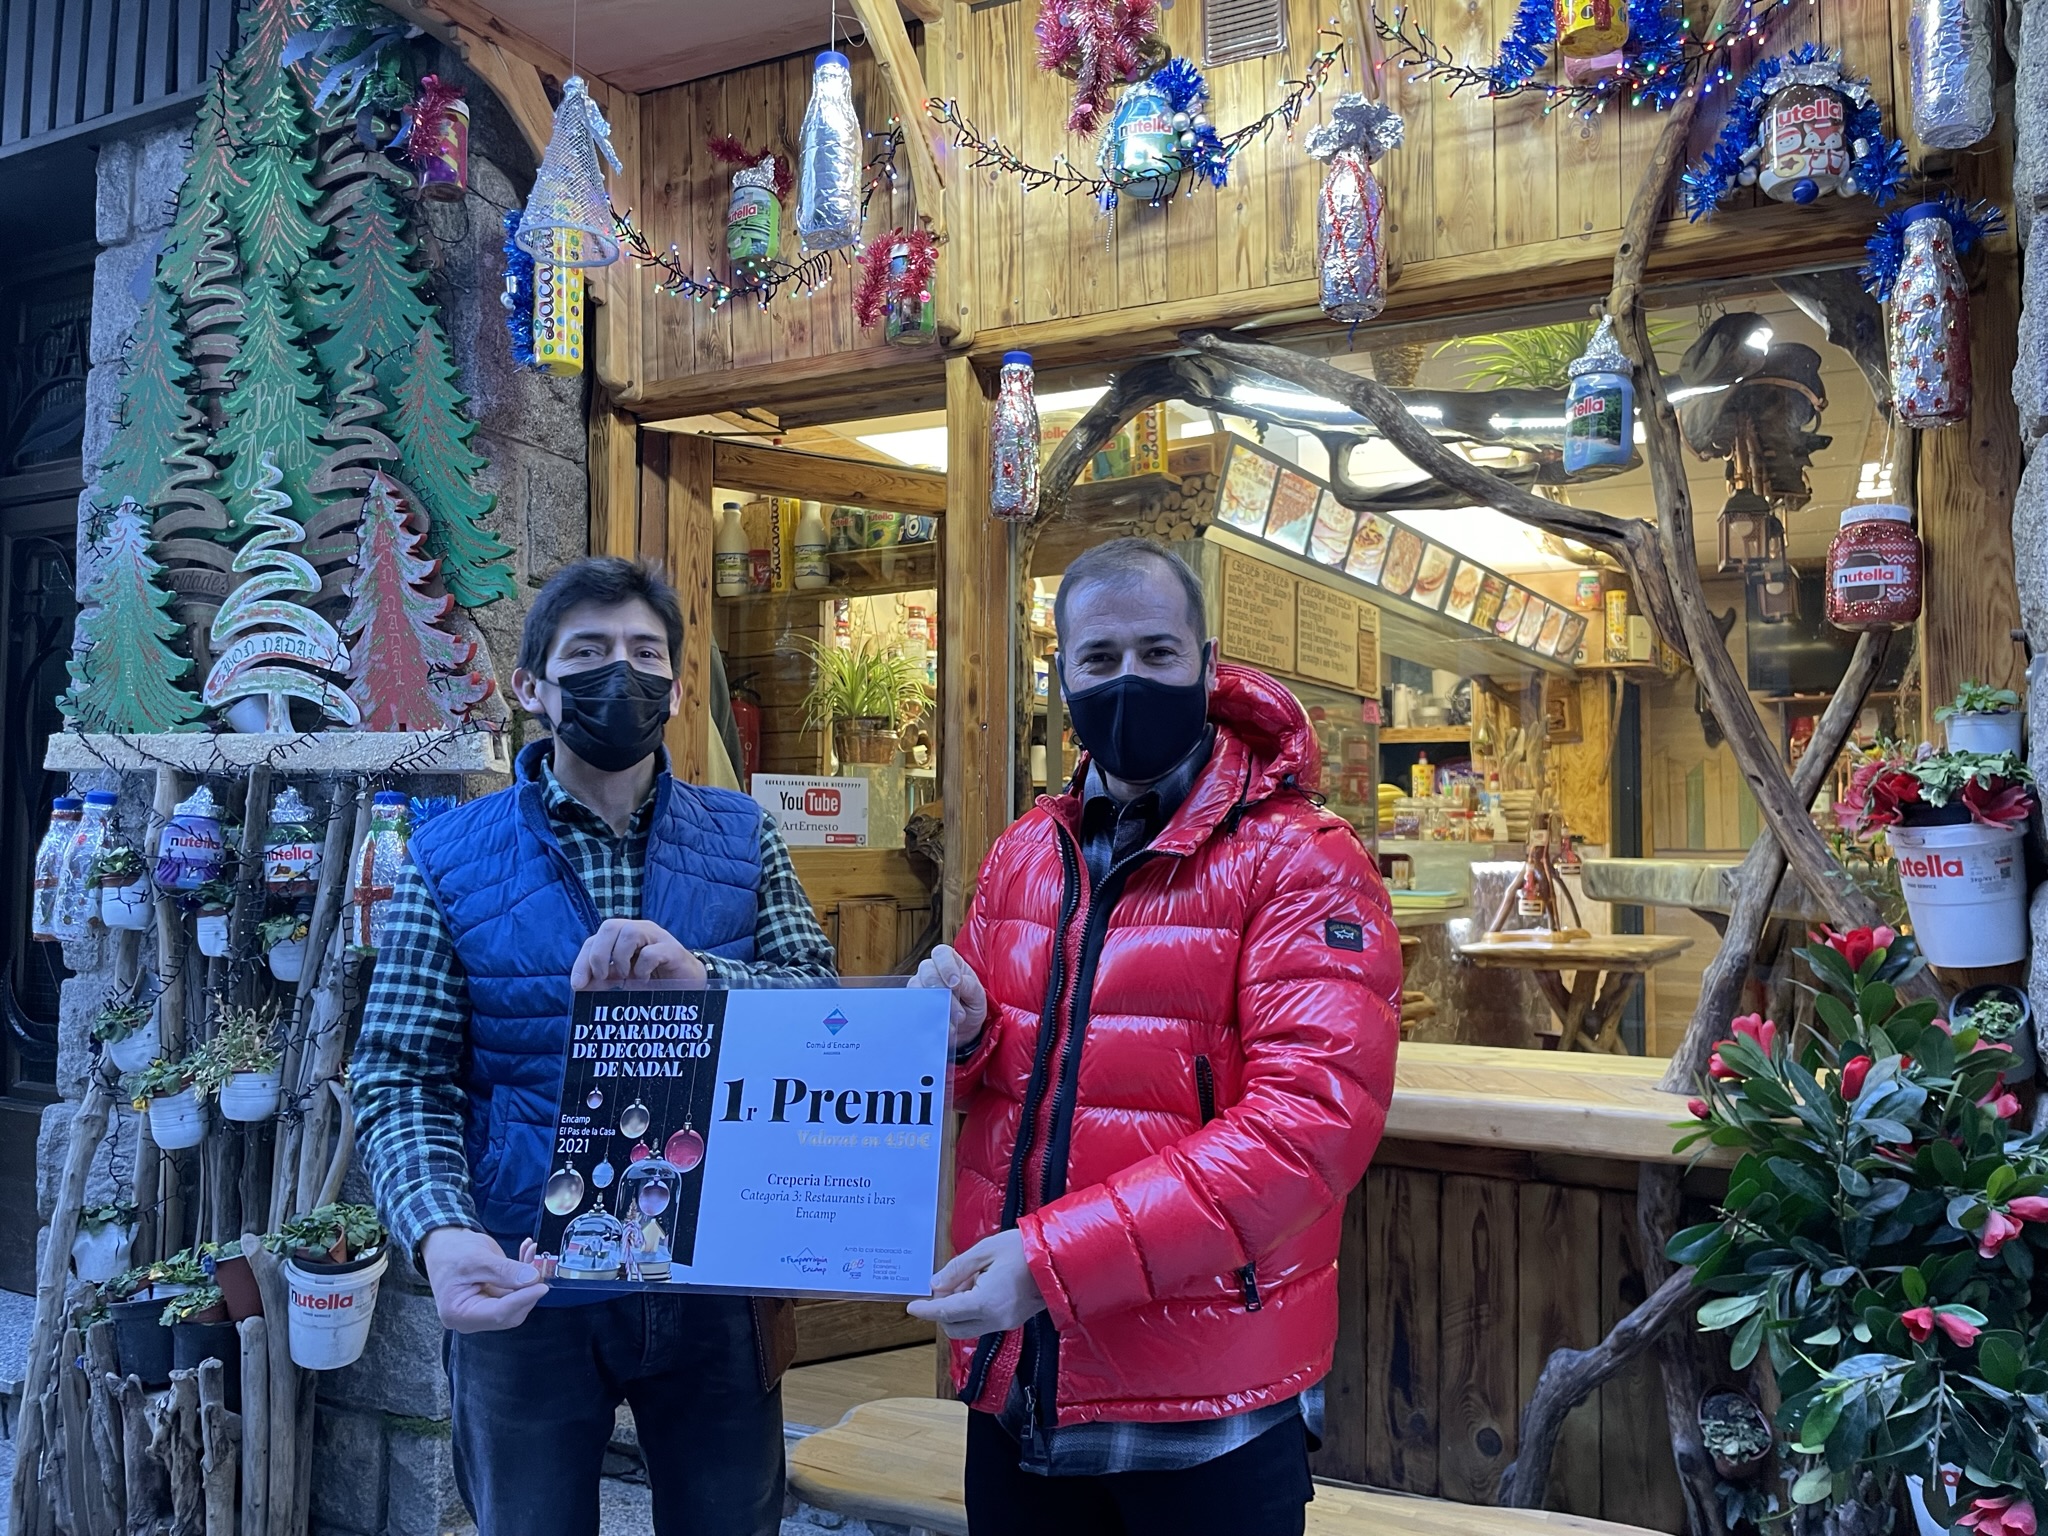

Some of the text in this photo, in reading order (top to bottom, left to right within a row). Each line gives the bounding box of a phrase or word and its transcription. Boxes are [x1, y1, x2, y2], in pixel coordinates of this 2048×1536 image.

[728, 203, 757, 224] utella
[1573, 397, 1604, 417] tella
[1840, 568, 1895, 584] nutella
[221, 636, 316, 674] BON NADAL
[780, 791, 839, 812] YouTube
[781, 821, 839, 832] ArtErnesto
[170, 836, 222, 850] nutella
[1899, 854, 1964, 878] utella
[594, 1005, 699, 1022] II CONCURS
[574, 1023, 715, 1040] D'APARADORS I
[572, 1038, 711, 1059] DE DECORACIÓ
[827, 1041, 861, 1050] d'Encamp
[593, 1061, 684, 1078] DE NADAL
[768, 1075, 935, 1126] Premi
[561, 1114, 591, 1126] Encamp
[559, 1126, 616, 1136] El Pas de la Casa
[797, 1129, 932, 1149] Valorat en 450€
[557, 1137, 590, 1153] 2021
[767, 1173, 871, 1188] Creperia Ernesto
[740, 1188, 896, 1205] Categoria 3: Restaurants i bars
[796, 1207, 837, 1222] Encamp
[292, 1288, 354, 1310] nutella
